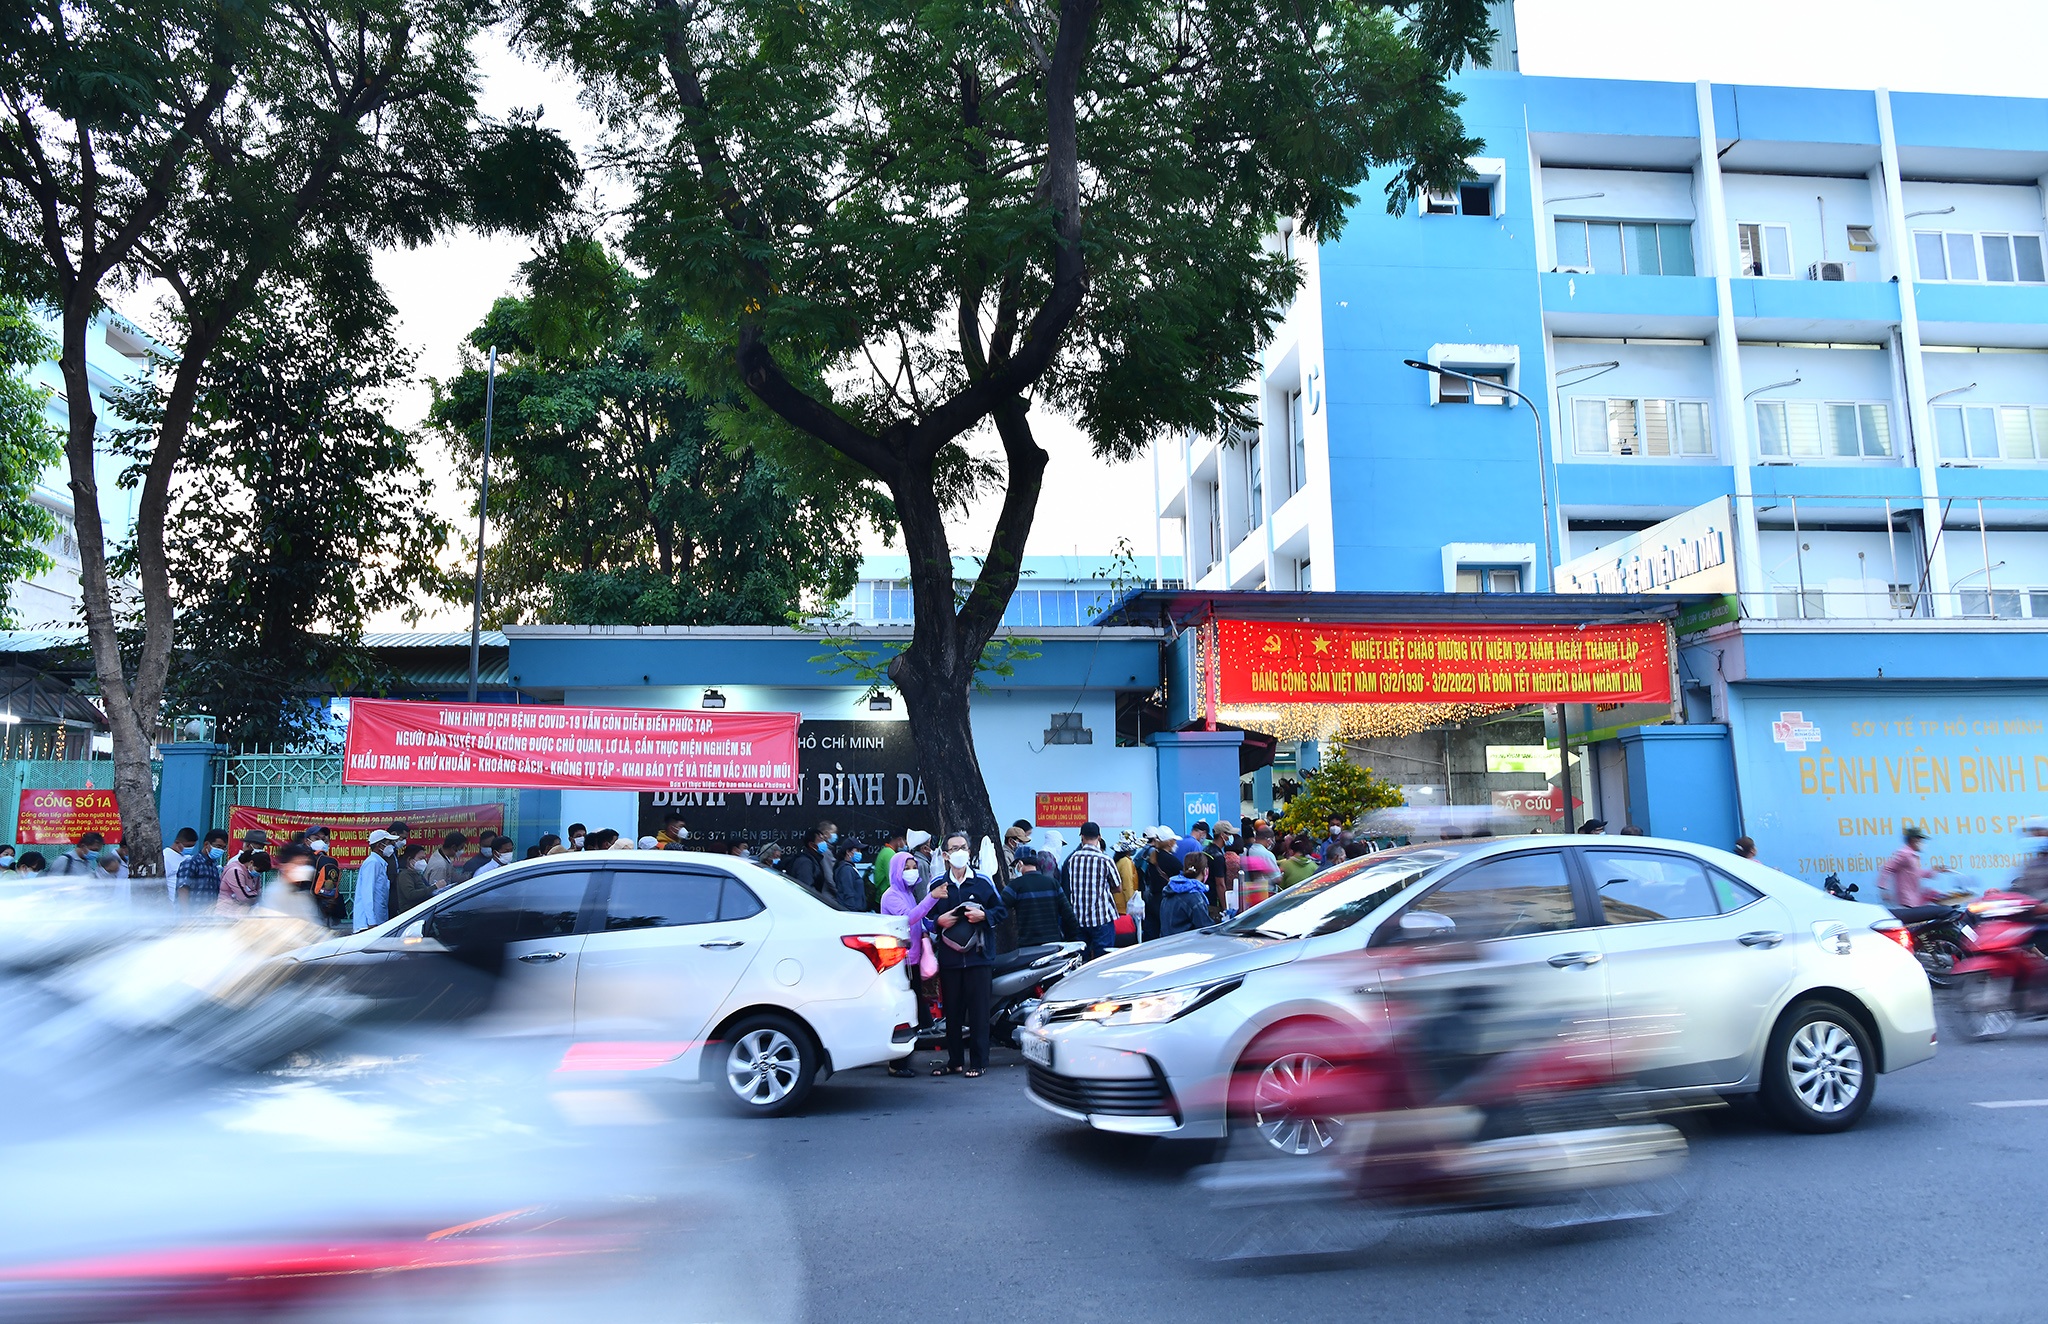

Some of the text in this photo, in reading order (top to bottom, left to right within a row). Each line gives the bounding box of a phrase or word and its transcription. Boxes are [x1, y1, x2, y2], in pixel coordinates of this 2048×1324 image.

[1675, 537, 1702, 579] BÌNH
[1699, 526, 1726, 571] DÂN
[1351, 636, 1640, 664] NHIỆT LIỆT CHÀO MỪNG KỶ NIỆM 92 NĂM NGÀY THÀNH LẬP
[1252, 665, 1279, 692] ĐẢNG
[1281, 667, 1308, 696] CỘNG
[1310, 665, 1330, 692] SẢN
[1332, 667, 1352, 696] VIỆT
[1354, 671, 1377, 692] NAM
[1379, 671, 1424, 694] (3/2/1930
[1432, 671, 1476, 694] 3/2/2022)
[1478, 667, 1491, 692] VÀ
[1492, 667, 1513, 692] ĐÓN
[1514, 668, 1530, 692] TẾT
[1532, 668, 1569, 692] NGUYÊN
[1593, 668, 1620, 692] NHÂM
[1622, 665, 1643, 692] DẦN
[439, 708, 714, 735] TÌNH HÌNH DỊCH BỆNH COVID-19 VẪN CÒN DIỄN BIẾN PHỨC TẠP,
[1879, 721, 1891, 736] Y
[1894, 714, 1915, 737] TẾ
[1919, 721, 1939, 736] TP
[1944, 714, 1966, 736] HỒ
[396, 729, 752, 758] NGƯỜI DÂN TUYỆT ĐỐI KHÔNG ĐƯỢC CHỦ QUAN, LƠ LÀ, CẦN THỰC HIỆN NGHIÊM 5K
[798, 732, 885, 749] HỒ CHÍ MINH
[350, 749, 791, 779] KHẨU TRANG KHỬ KHUẨN KHOẢNG CÁCH KHÔNG TỤ TẬP KHAI BÁO Y TẾ VÀ TIÊM VẮC XIN ĐỦ MŨI
[1799, 746, 2026, 801] BỆNH VIỆN BÌNH
[688, 780, 701, 789] thực
[737, 781, 752, 789] nhân
[753, 780, 764, 789] dân
[818, 762, 885, 806] BÌNH
[33, 791, 111, 808] CỔNG SỐ 1A
[1188, 796, 1217, 815] CỔNG
[1495, 795, 1552, 811] CẤP CỨU
[257, 814, 273, 826] PHẠT
[275, 813, 289, 825] TIỀN
[469, 812, 477, 822] VI
[1838, 816, 1949, 836] BINH DAN
[275, 828, 289, 842] HIỆN
[340, 830, 356, 842] DỤNG
[409, 827, 422, 840] CHẾ
[424, 827, 437, 841] TẬP
[708, 830, 726, 840] 371
[760, 828, 787, 840] BIÊN
[332, 841, 480, 858] ĐỘNG KINH CỘNG
[1847, 852, 1874, 874] BIÊN
